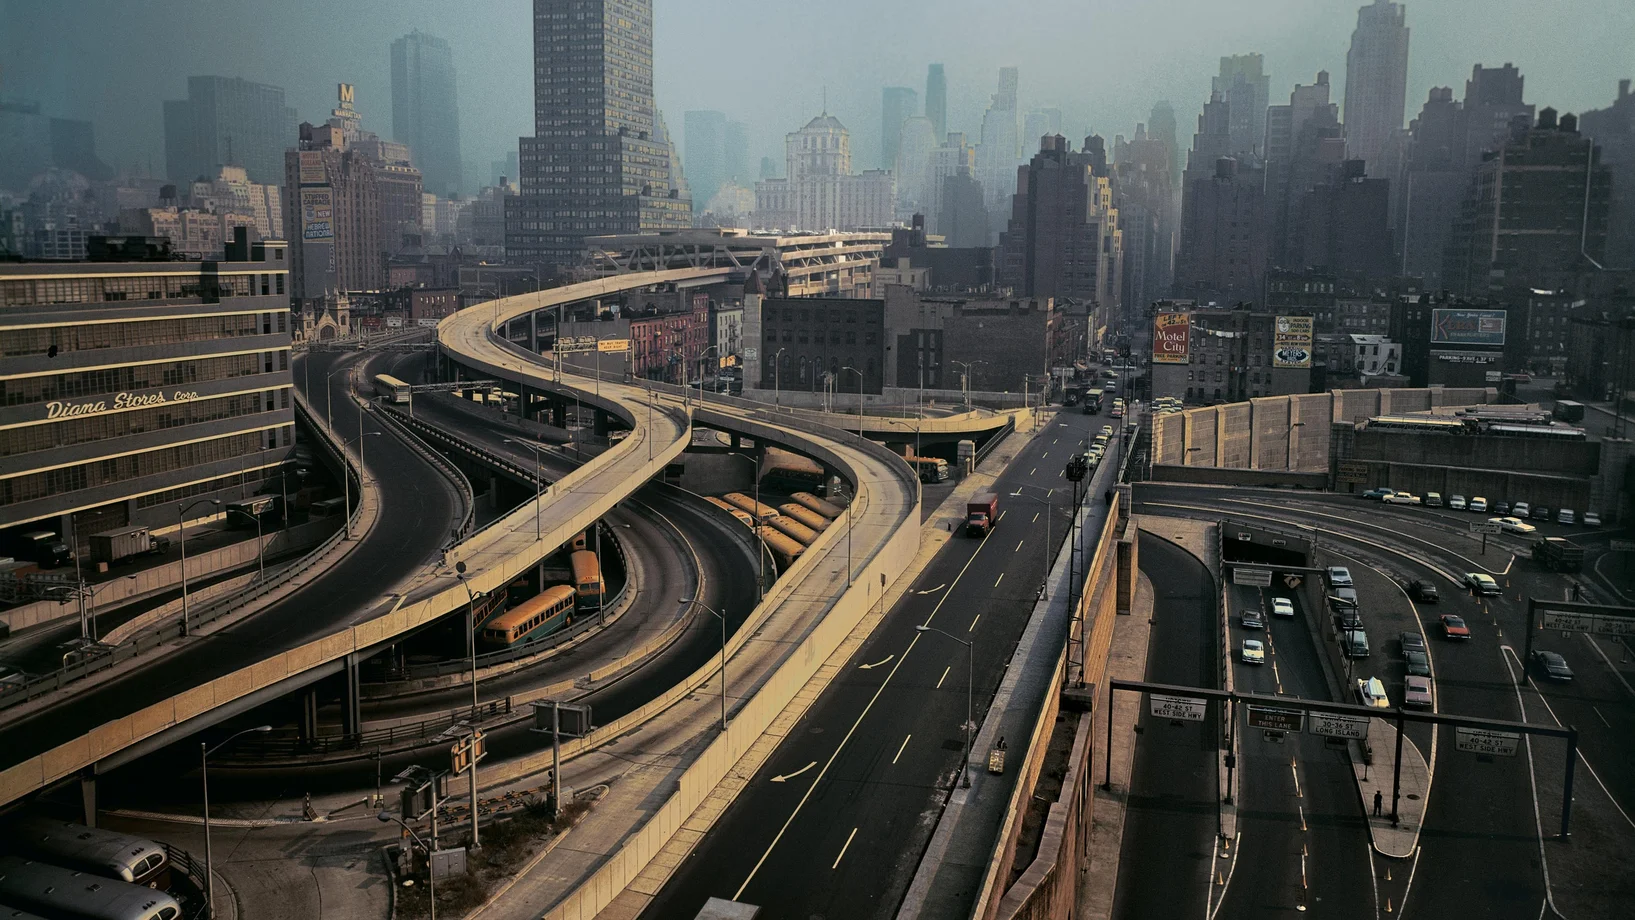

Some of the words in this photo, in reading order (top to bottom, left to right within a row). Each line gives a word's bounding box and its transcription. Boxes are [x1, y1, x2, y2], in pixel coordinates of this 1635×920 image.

[341, 83, 354, 102] M
[307, 223, 329, 231] HEBREW
[1155, 331, 1186, 341] Motel
[1163, 341, 1185, 354] City
[46, 401, 107, 419] Diana
[113, 392, 166, 409] Stores
[173, 391, 199, 402] Corp.
[1322, 721, 1343, 729] 30-36
[1469, 738, 1492, 746] 40-42
